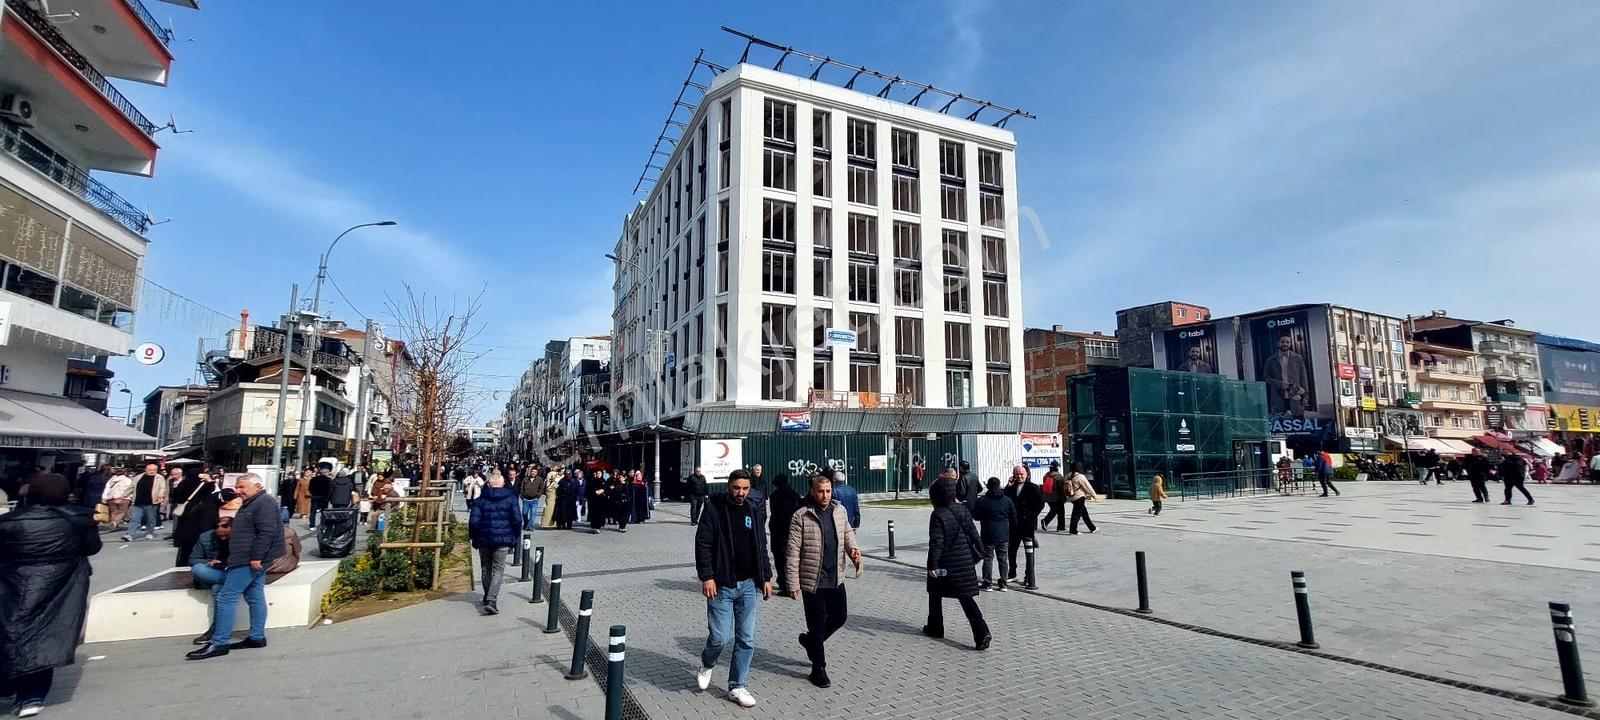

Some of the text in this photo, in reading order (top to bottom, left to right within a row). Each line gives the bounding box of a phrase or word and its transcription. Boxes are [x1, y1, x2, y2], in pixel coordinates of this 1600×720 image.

[1277, 317, 1295, 327] tabii
[1188, 329, 1204, 338] tabii
[1269, 418, 1323, 432] ASSAL
